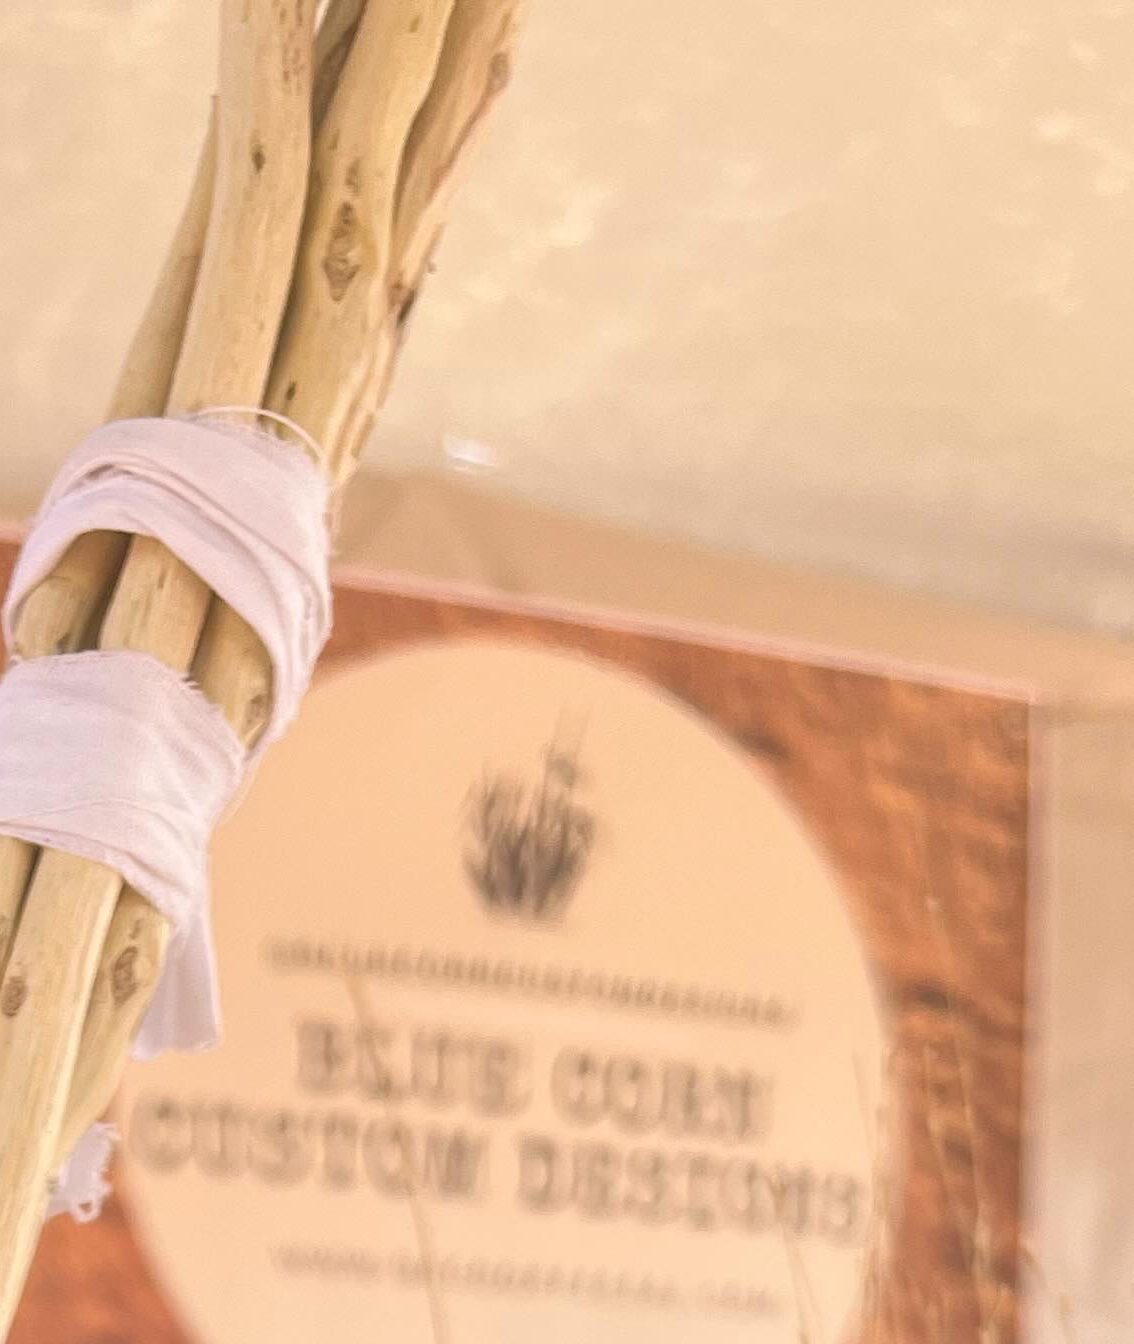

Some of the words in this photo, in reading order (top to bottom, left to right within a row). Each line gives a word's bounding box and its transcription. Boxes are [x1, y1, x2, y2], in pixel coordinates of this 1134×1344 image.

[297, 1019, 533, 1118] BLUE
[550, 1043, 775, 1140] CORN
[129, 1094, 490, 1196] CUSTOM
[516, 1131, 869, 1246] DESIGNS
